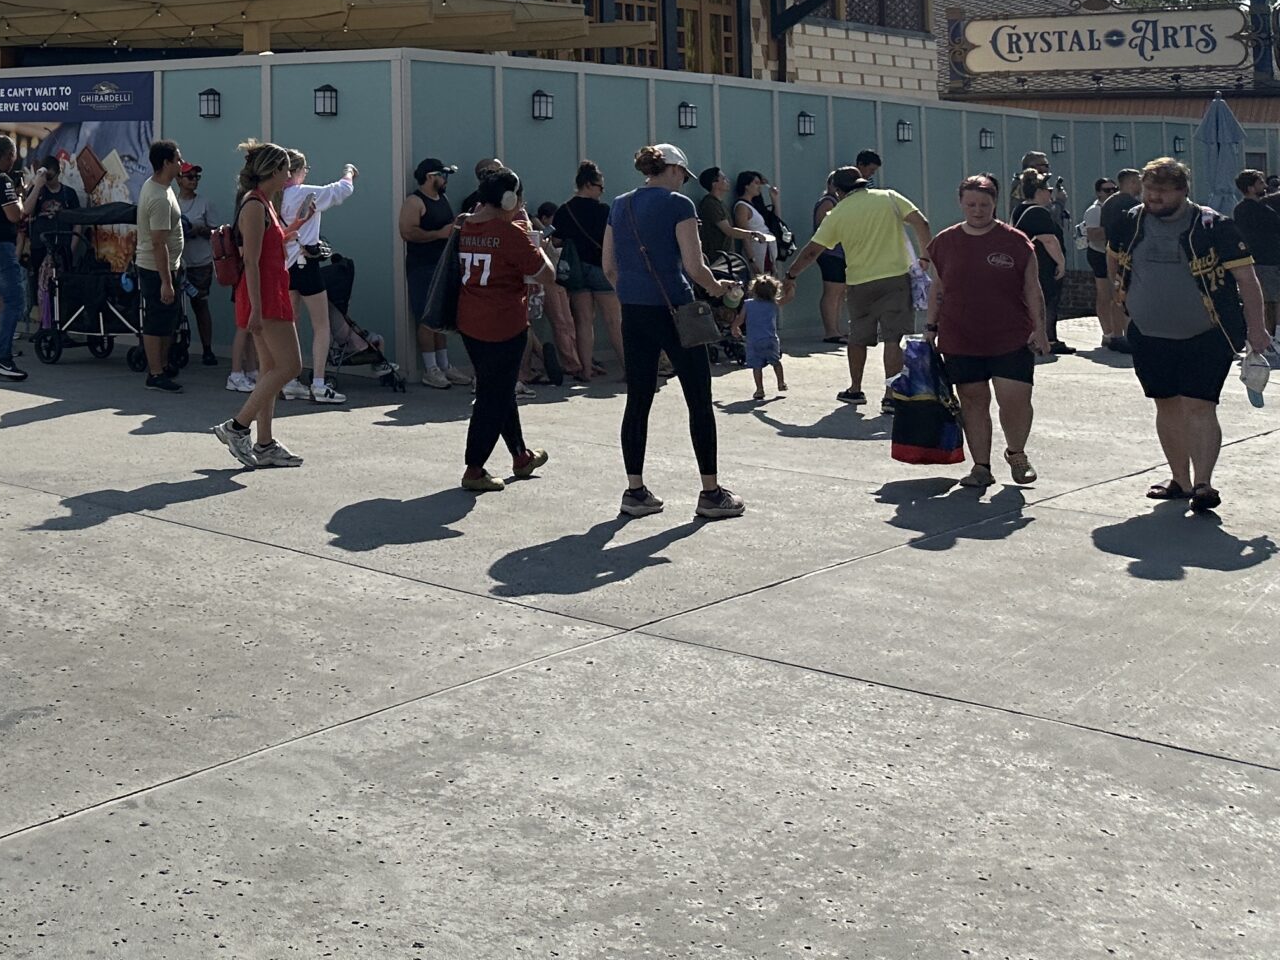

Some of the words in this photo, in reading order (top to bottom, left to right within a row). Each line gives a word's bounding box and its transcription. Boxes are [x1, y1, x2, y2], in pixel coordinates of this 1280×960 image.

[990, 24, 1101, 63] CRYSTAL
[1129, 19, 1218, 62] ARTS
[7, 87, 32, 97] CAN'T
[34, 86, 57, 97] WAIT
[58, 86, 72, 96] TO
[80, 93, 131, 103] GHIRARDELLI
[21, 102, 40, 112] YOU
[41, 101, 69, 111] SOON!
[458, 252, 492, 286] 77
